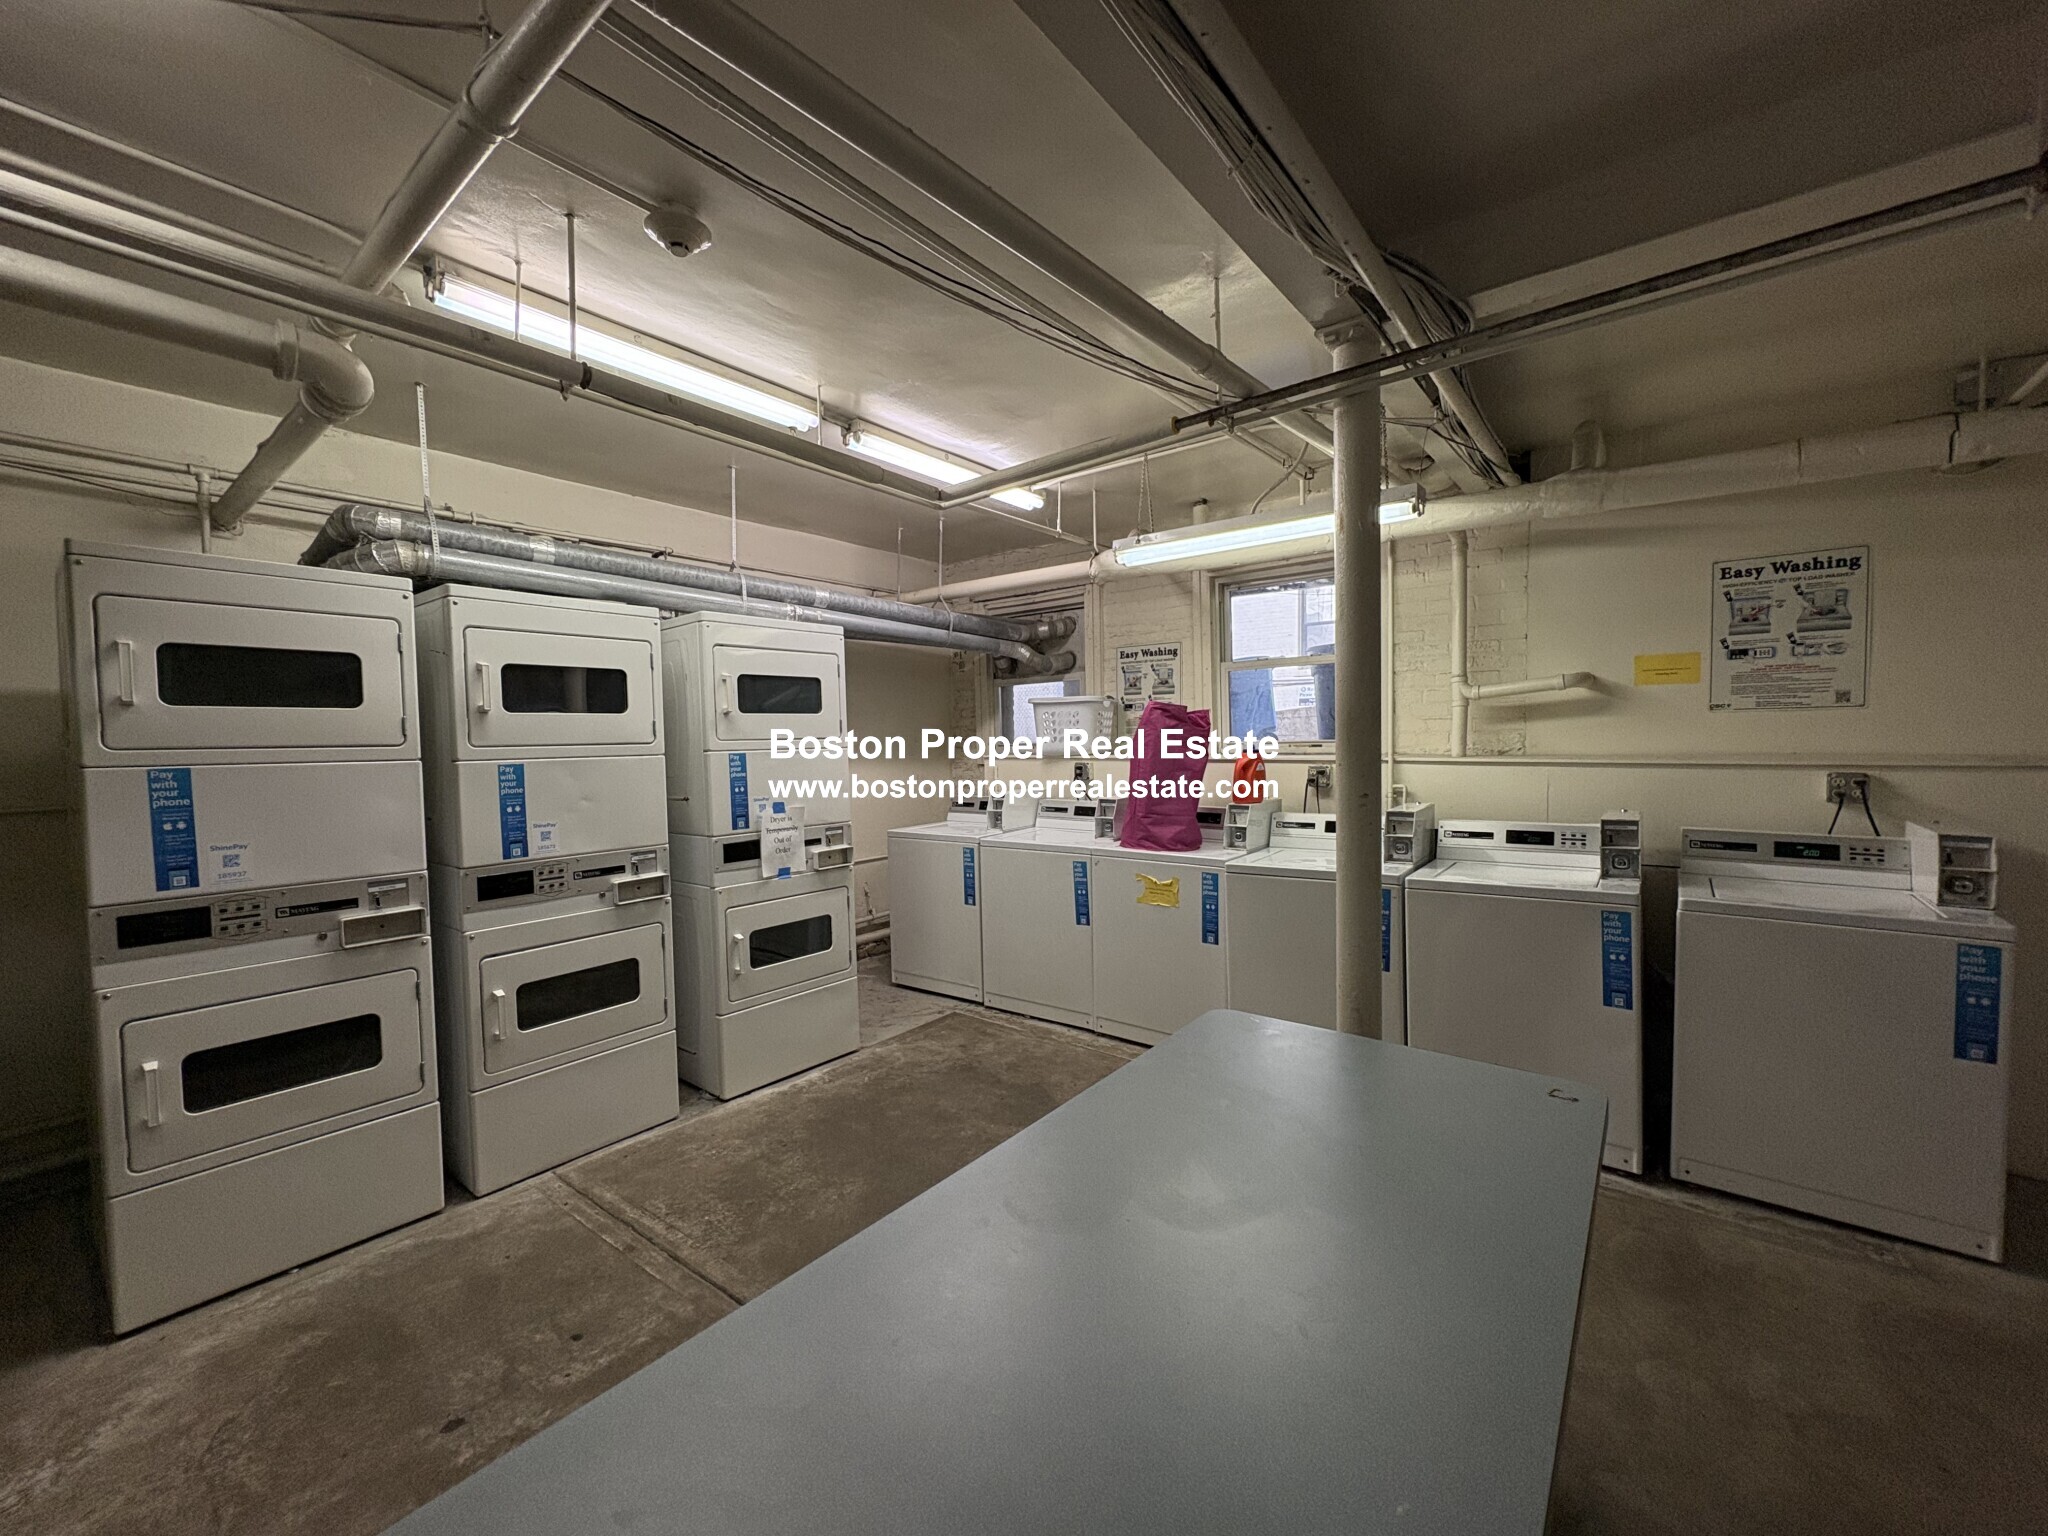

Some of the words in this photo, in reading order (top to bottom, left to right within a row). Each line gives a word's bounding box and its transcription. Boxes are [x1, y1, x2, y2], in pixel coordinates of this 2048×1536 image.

[1720, 566, 1765, 580] Easy
[1770, 556, 1862, 575] Washing
[1120, 650, 1139, 660] Easy
[1141, 647, 1178, 657] Washing
[500, 765, 514, 773] Pay
[150, 770, 173, 780] Pay
[500, 773, 516, 781] with
[151, 780, 178, 789] with
[500, 781, 517, 789] your
[151, 790, 179, 800] your
[501, 787, 524, 796] phone
[152, 798, 191, 809] phone
[1603, 911, 1619, 920] Pay
[1603, 920, 1622, 928] with
[1603, 934, 1631, 943] phone
[1959, 945, 1984, 956] Pay
[1959, 955, 1988, 965] with
[1960, 964, 1987, 973] your
[1959, 971, 1998, 984] phone
